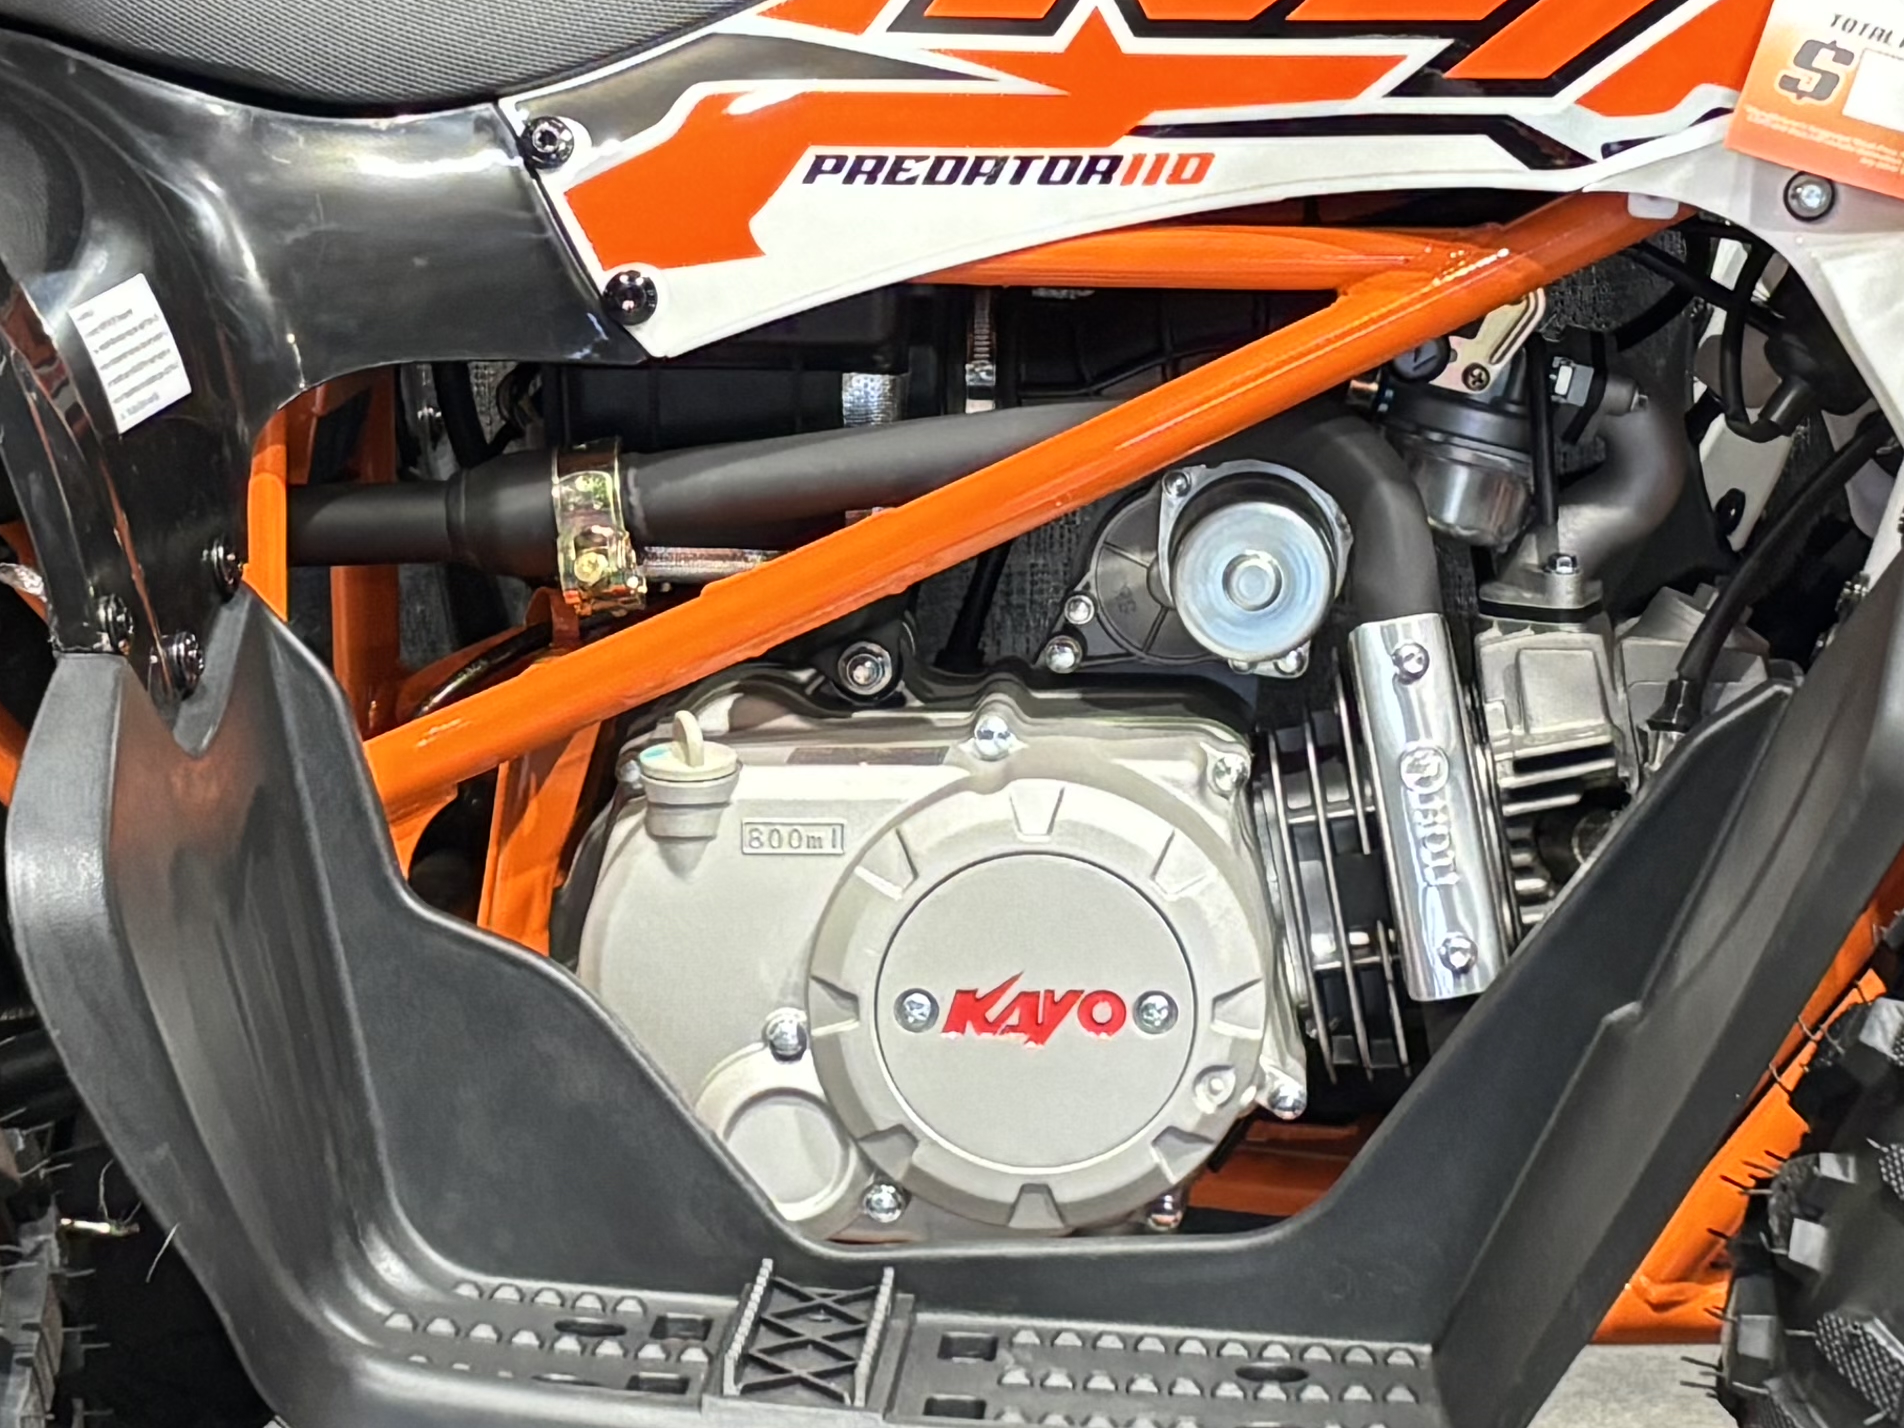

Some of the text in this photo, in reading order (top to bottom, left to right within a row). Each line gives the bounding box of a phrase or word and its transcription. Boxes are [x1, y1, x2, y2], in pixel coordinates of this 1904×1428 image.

[1829, 12, 1895, 46] TOTAL
[747, 827, 842, 851] 800ml
[941, 971, 1128, 1049] KAYO
